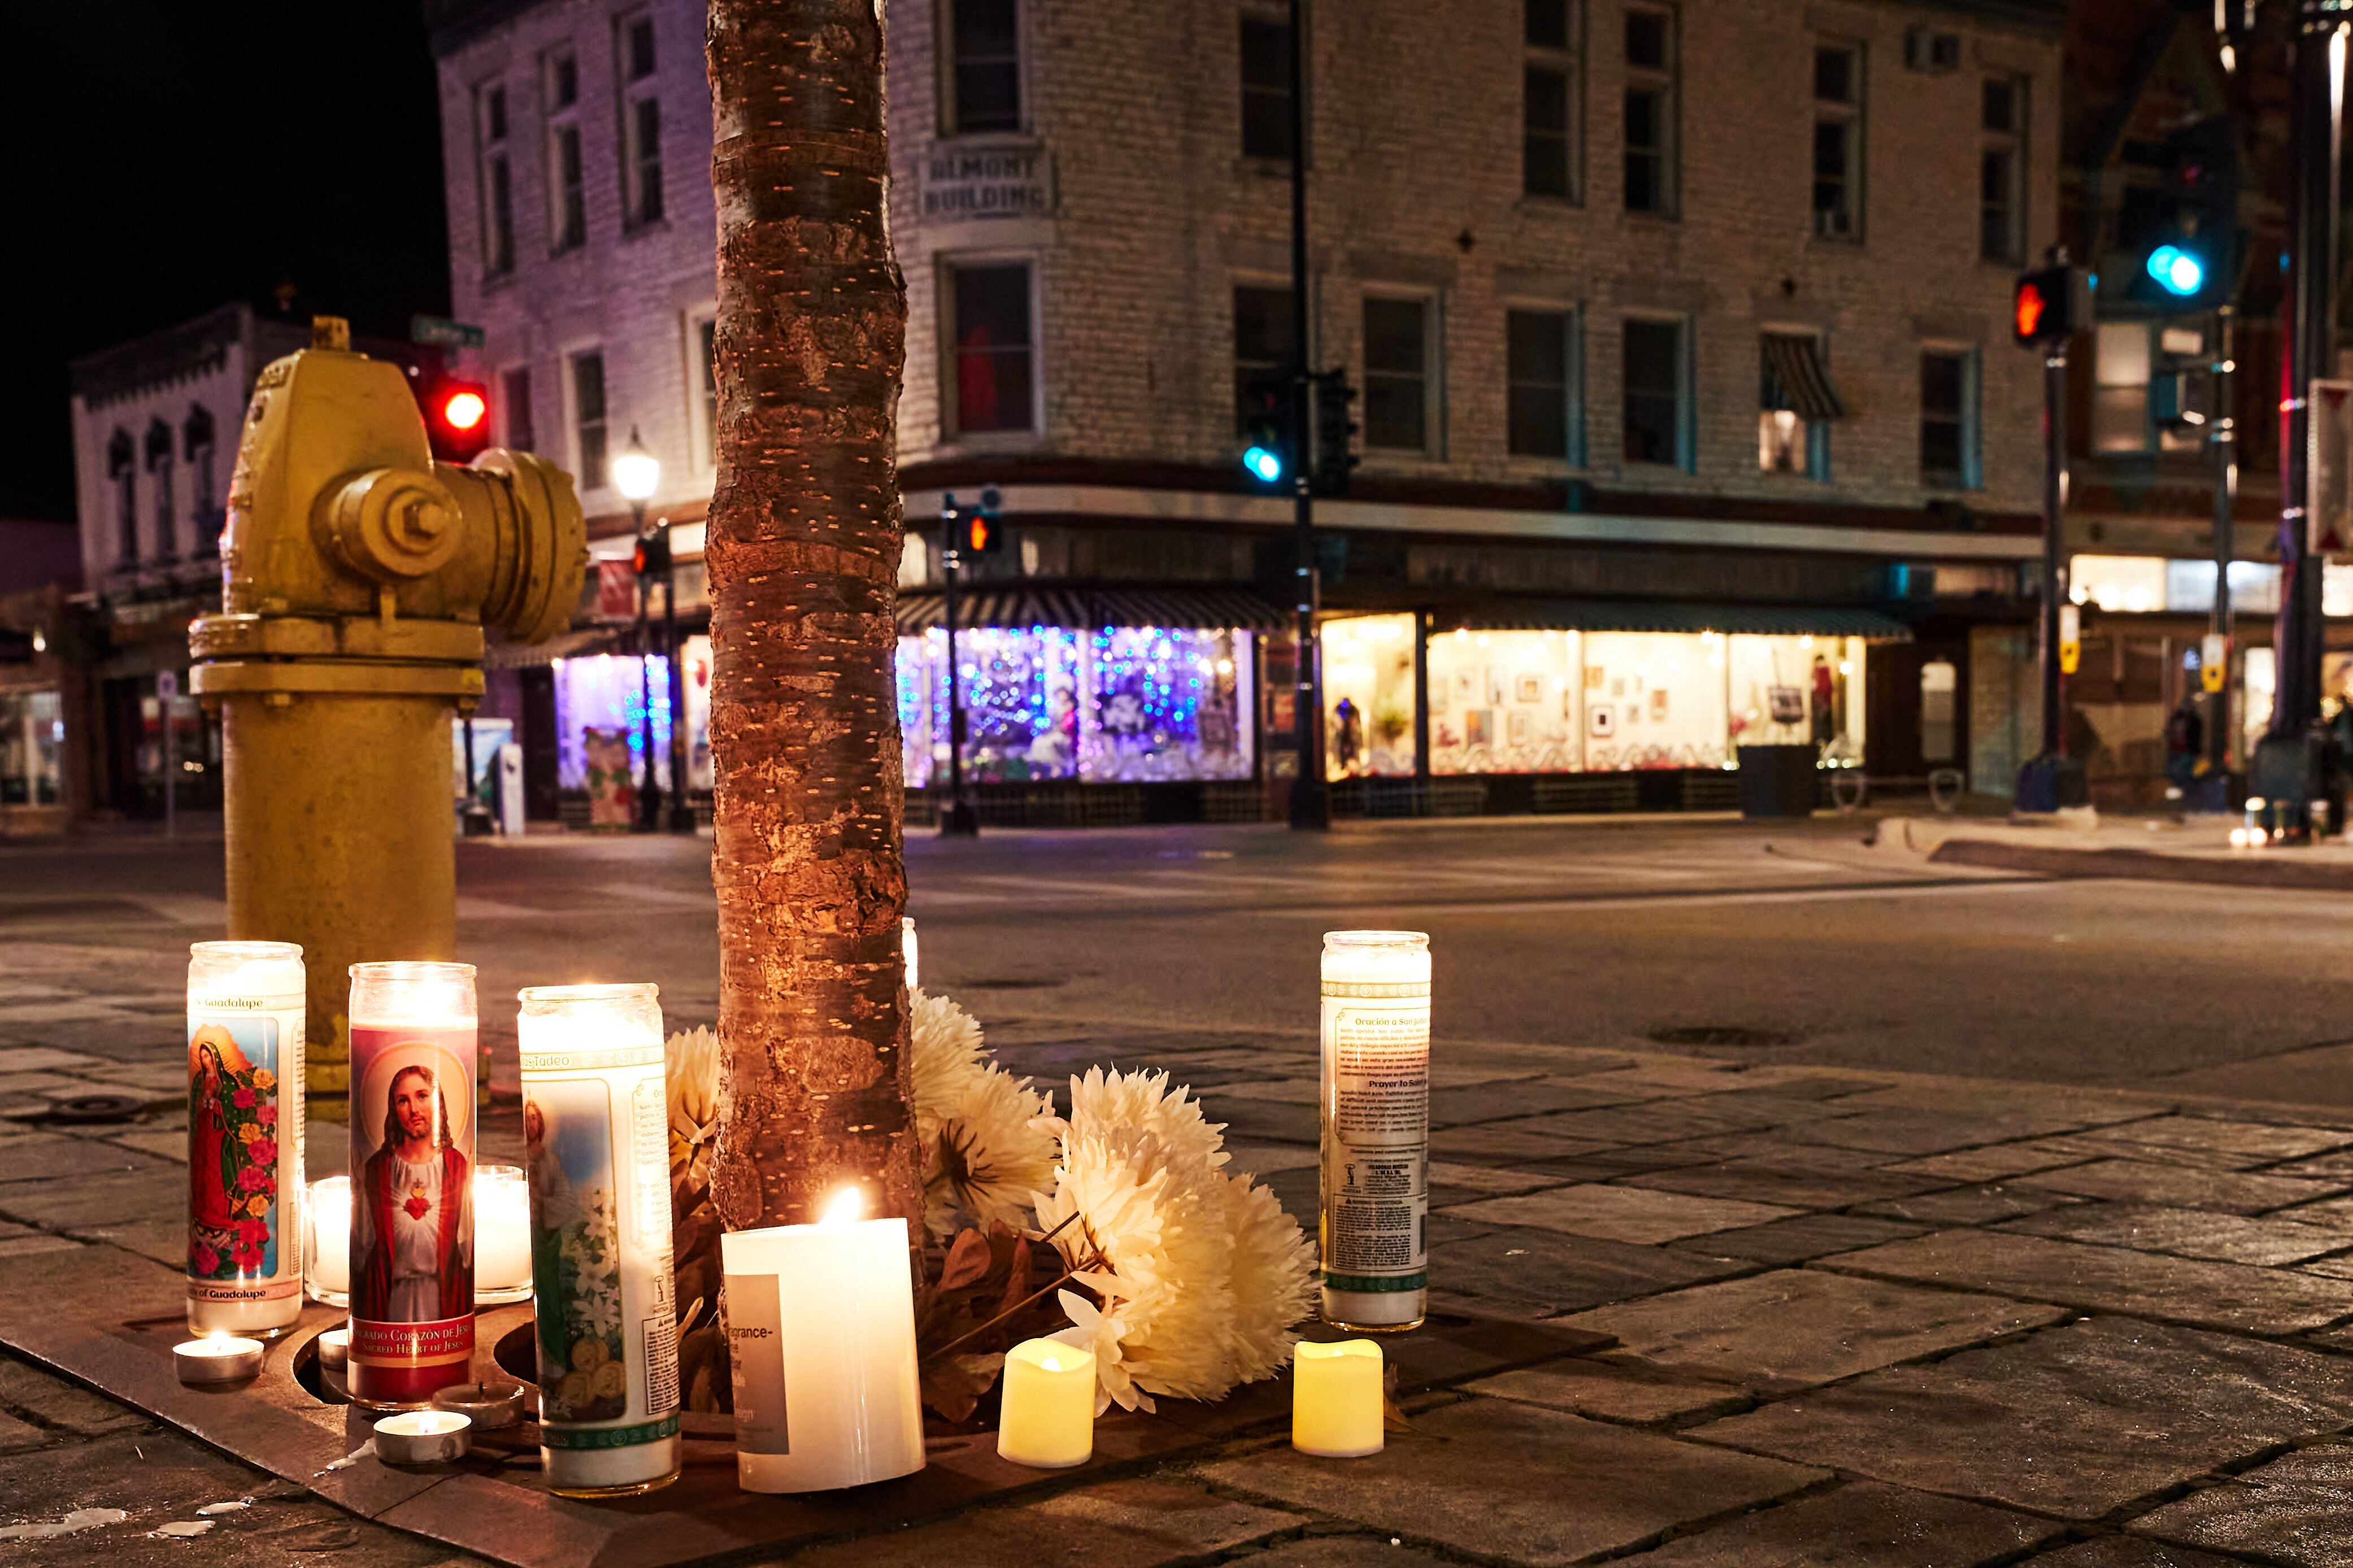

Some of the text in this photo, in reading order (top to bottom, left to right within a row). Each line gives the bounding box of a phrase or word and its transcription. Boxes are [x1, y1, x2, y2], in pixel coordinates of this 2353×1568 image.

[925, 185, 1045, 212] BUILDING
[205, 998, 263, 1010] Guadalupe
[534, 1055, 569, 1067] Tadeo
[1369, 1081, 1398, 1089] Prayer
[199, 1288, 208, 1297] of
[210, 1290, 266, 1300] Guadalupe
